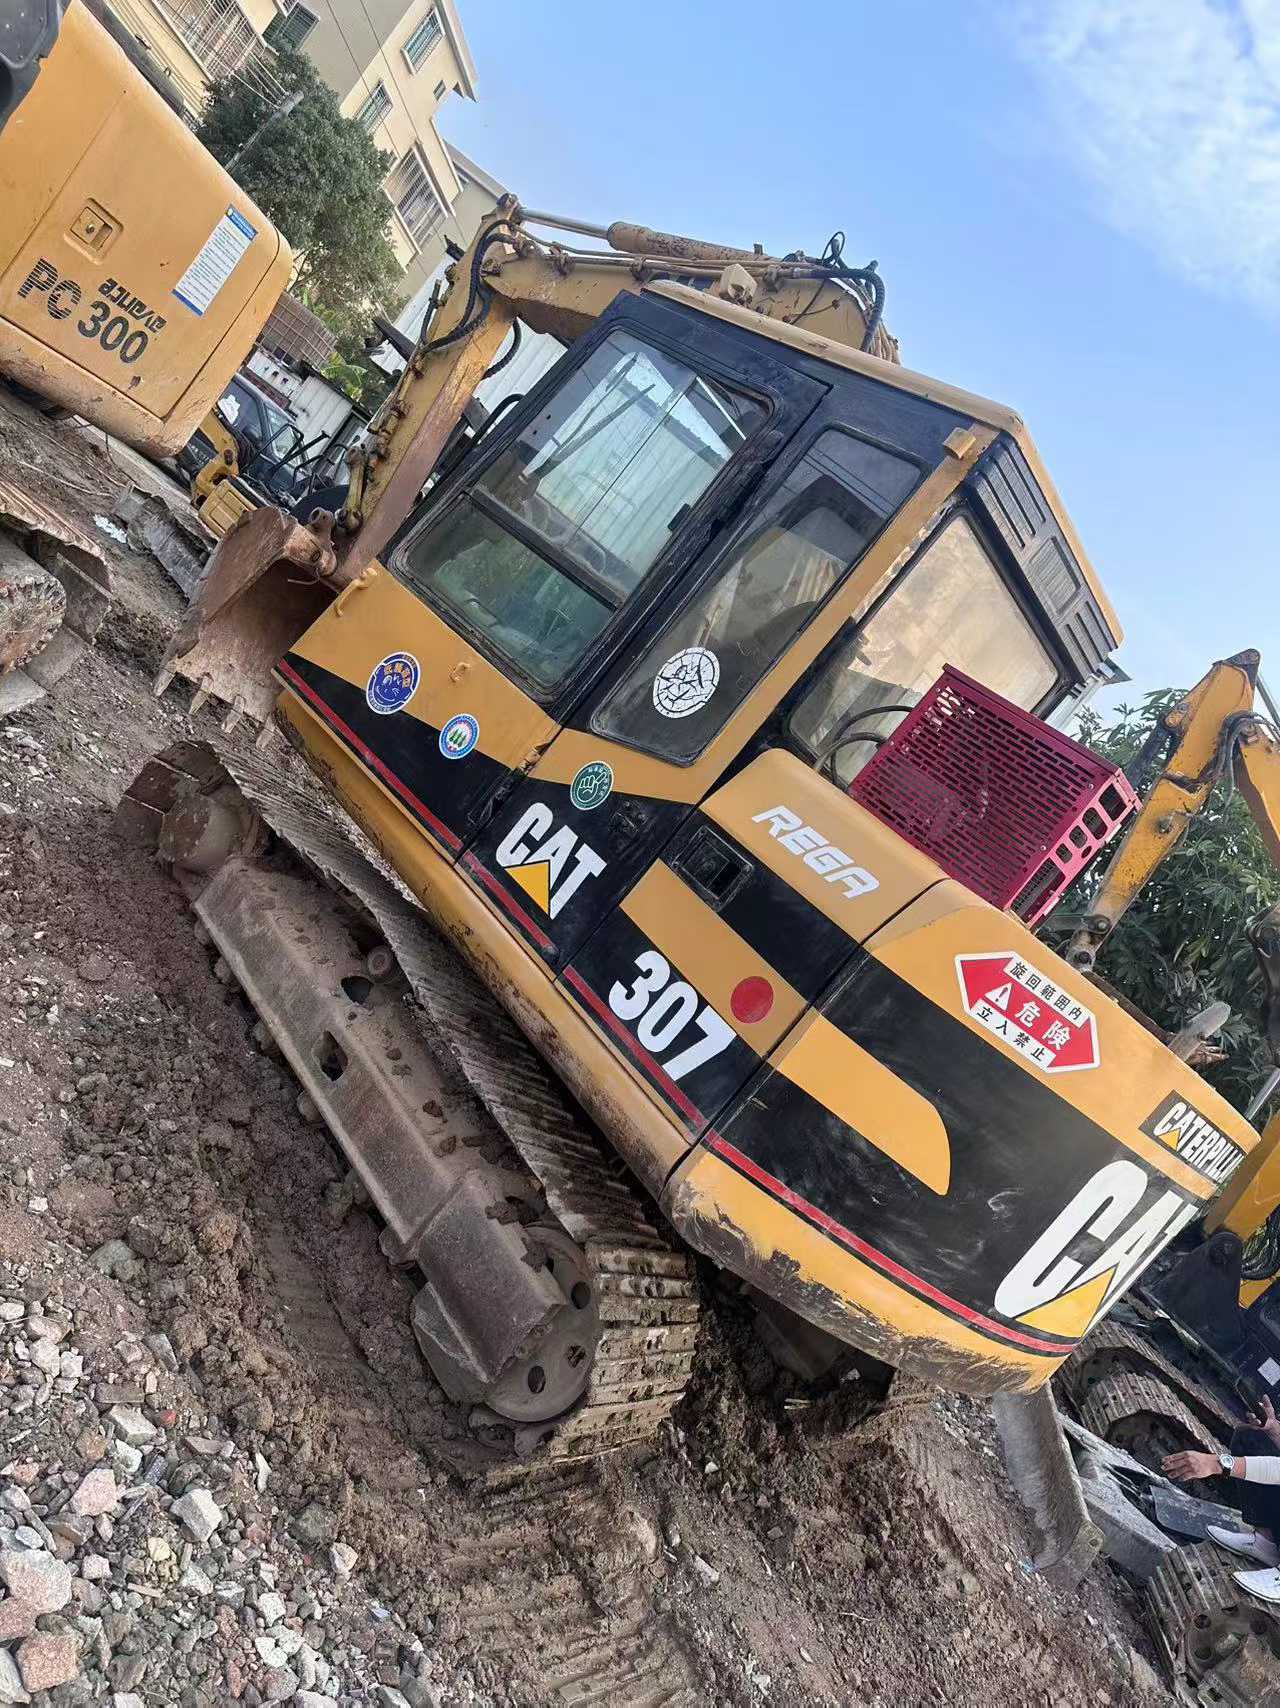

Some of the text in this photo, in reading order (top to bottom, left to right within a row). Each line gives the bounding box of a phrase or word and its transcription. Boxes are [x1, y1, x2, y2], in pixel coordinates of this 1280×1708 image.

[18, 257, 148, 363] PC 300
[495, 802, 607, 920] CAT
[751, 805, 880, 899] REGA
[608, 950, 737, 1081] 307
[976, 1006, 1045, 1062] 立入禁止
